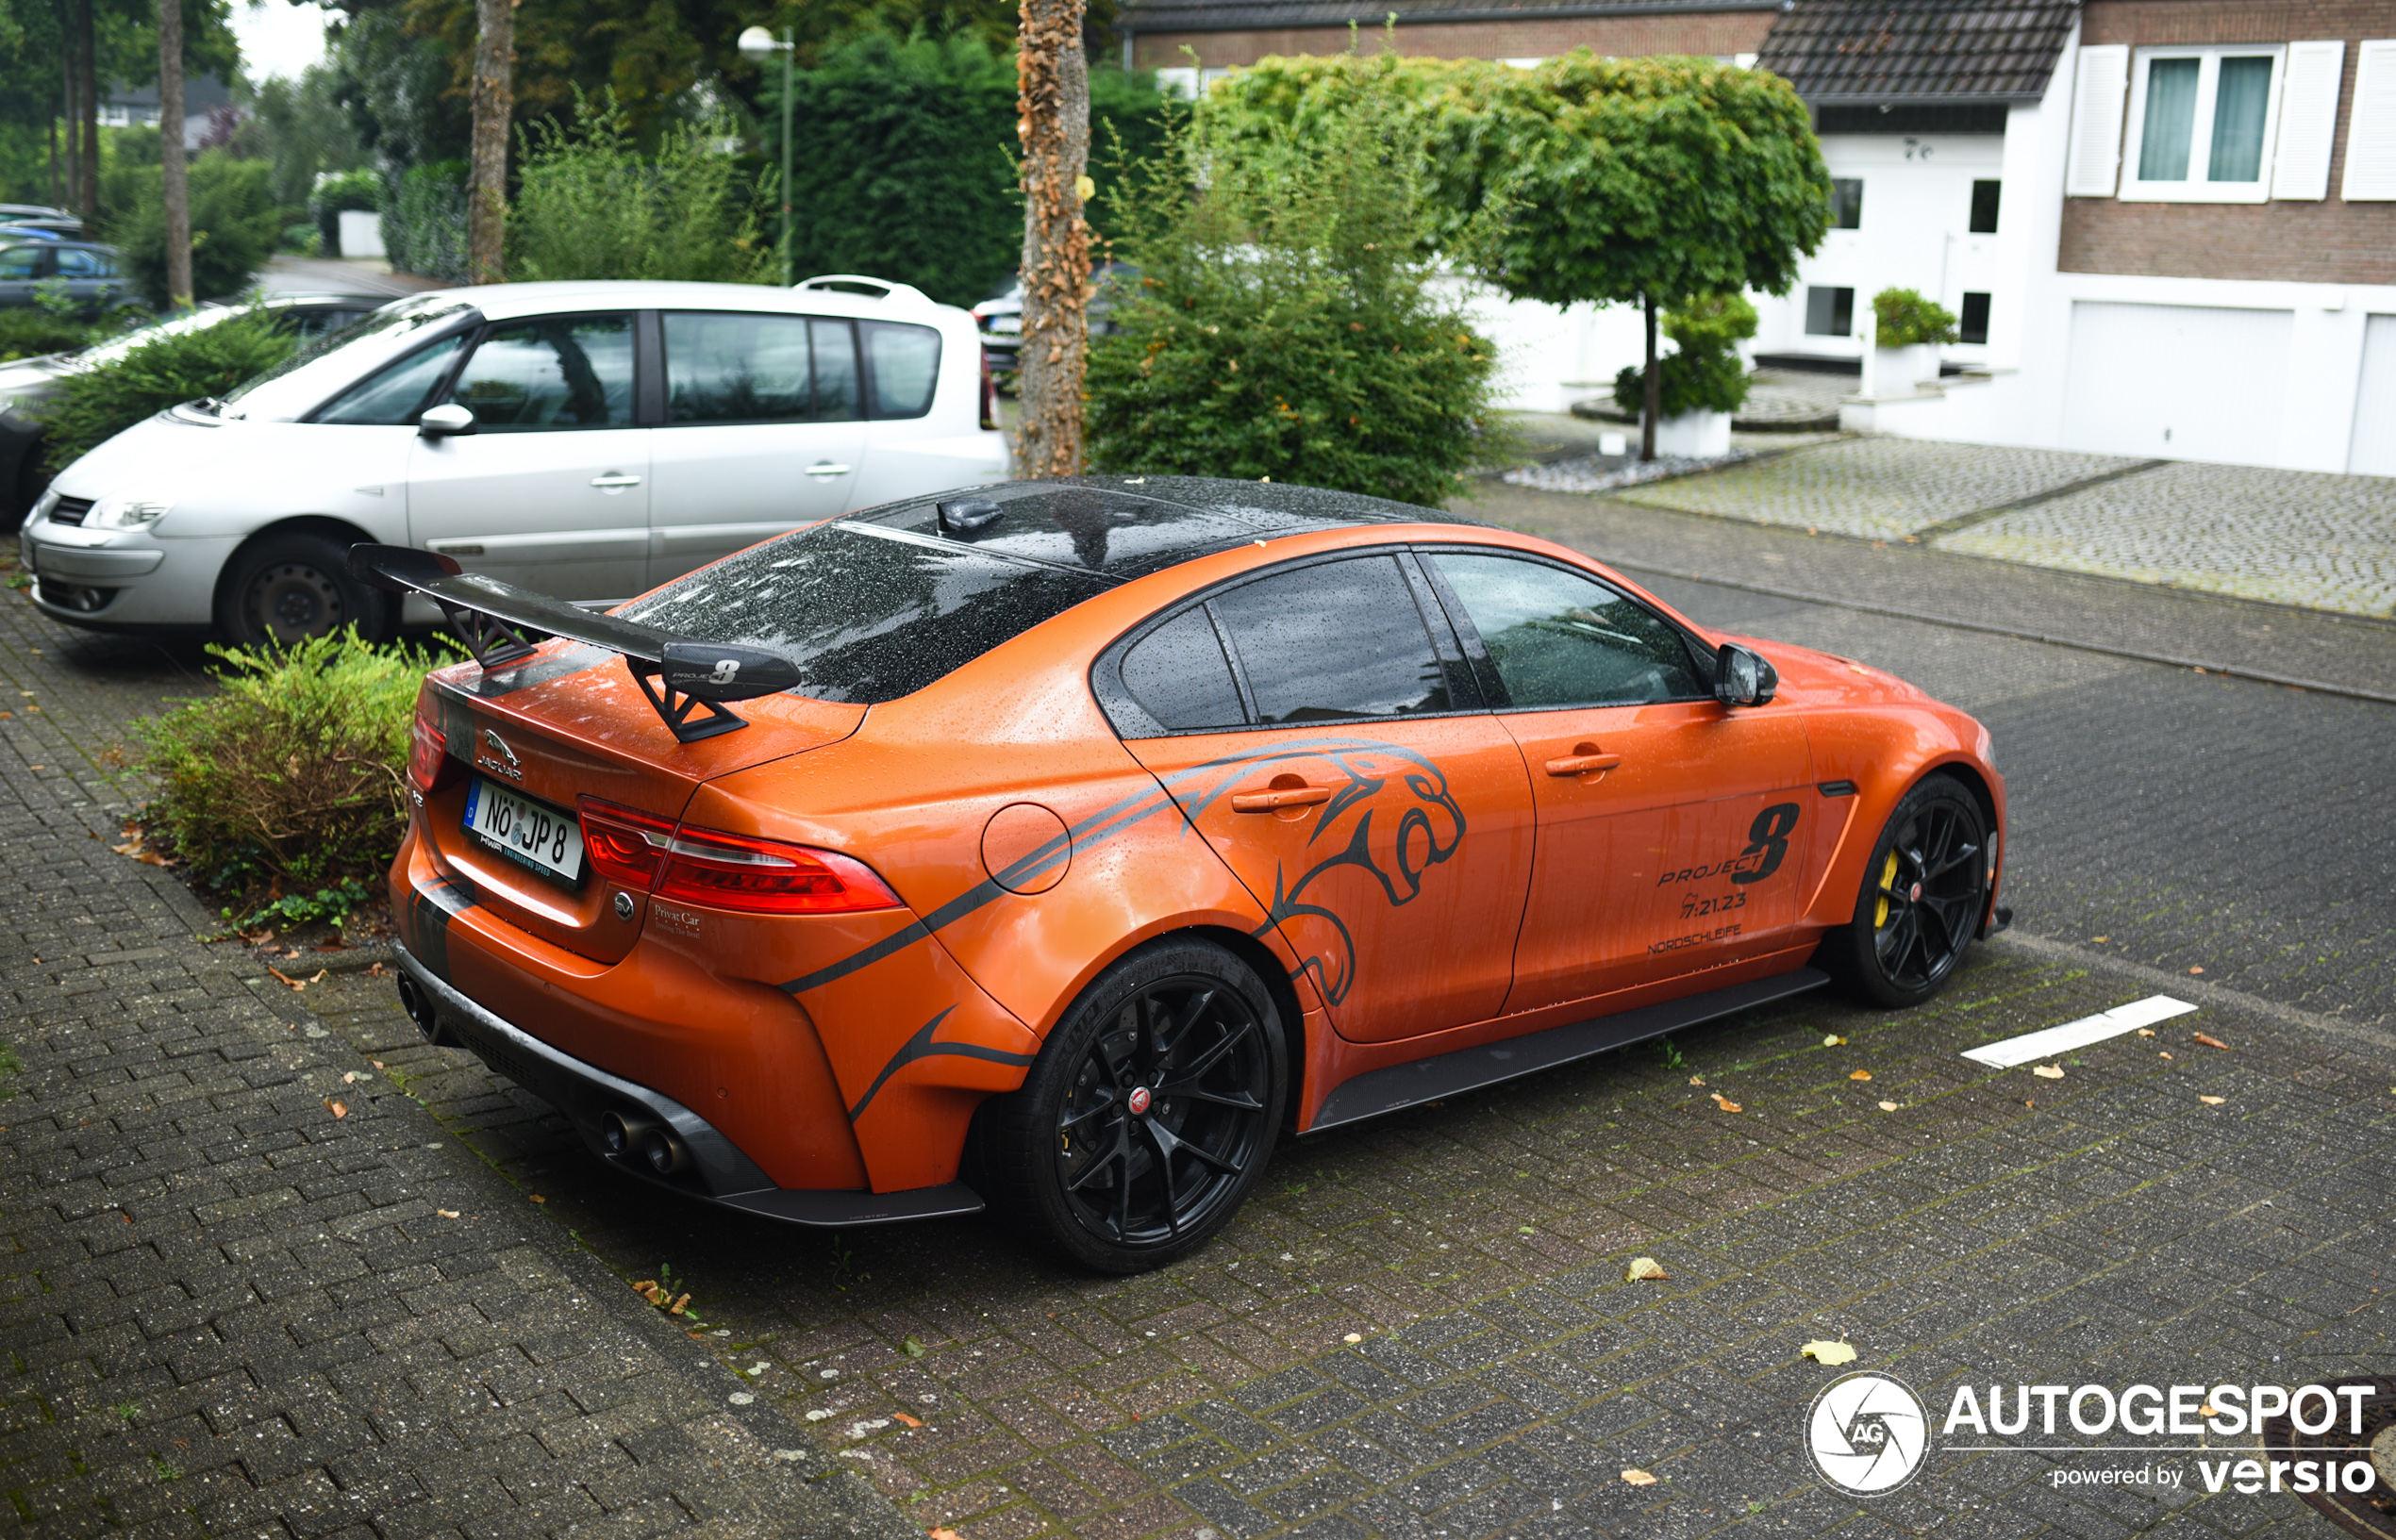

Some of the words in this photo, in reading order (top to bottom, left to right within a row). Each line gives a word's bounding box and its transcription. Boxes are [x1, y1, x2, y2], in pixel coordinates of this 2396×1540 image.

[708, 659, 740, 685] 8
[477, 755, 523, 781] JAGUAR
[485, 791, 515, 837] NÖ
[522, 810, 551, 854] JP
[552, 823, 568, 865] 8
[480, 835, 503, 853] HWA
[1657, 853, 1763, 887] PROJECT
[1730, 803, 1801, 885] 8
[655, 904, 680, 921] Privat
[681, 912, 700, 925] Car
[1684, 892, 1747, 919] 7:21.23
[1647, 923, 1742, 955] NORDSCHLEIFE
